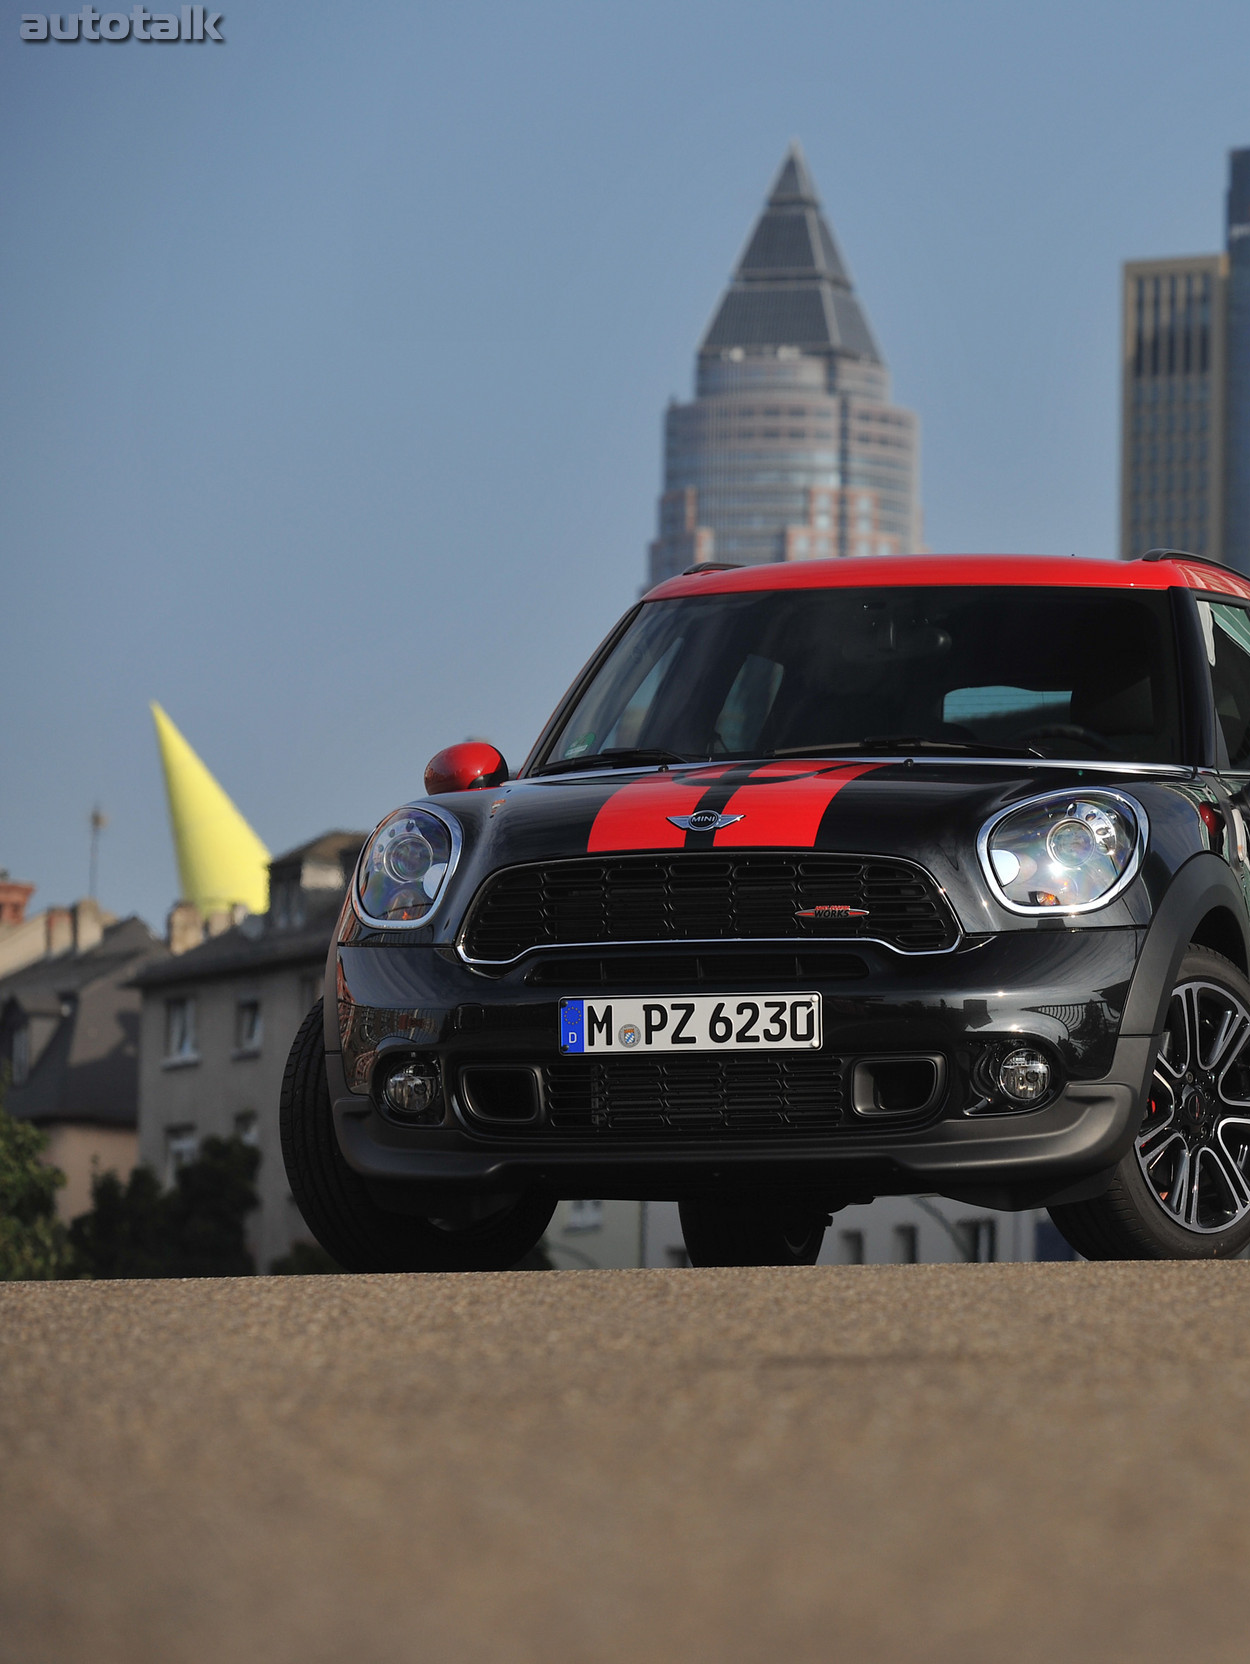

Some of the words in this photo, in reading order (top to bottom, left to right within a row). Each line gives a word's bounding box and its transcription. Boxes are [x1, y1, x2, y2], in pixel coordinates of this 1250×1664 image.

[691, 815, 715, 823] MINI
[814, 909, 850, 918] WORKS
[587, 1004, 613, 1047] M
[642, 1003, 697, 1045] PZ
[708, 1000, 815, 1043] 6230
[568, 1031, 578, 1044] D
